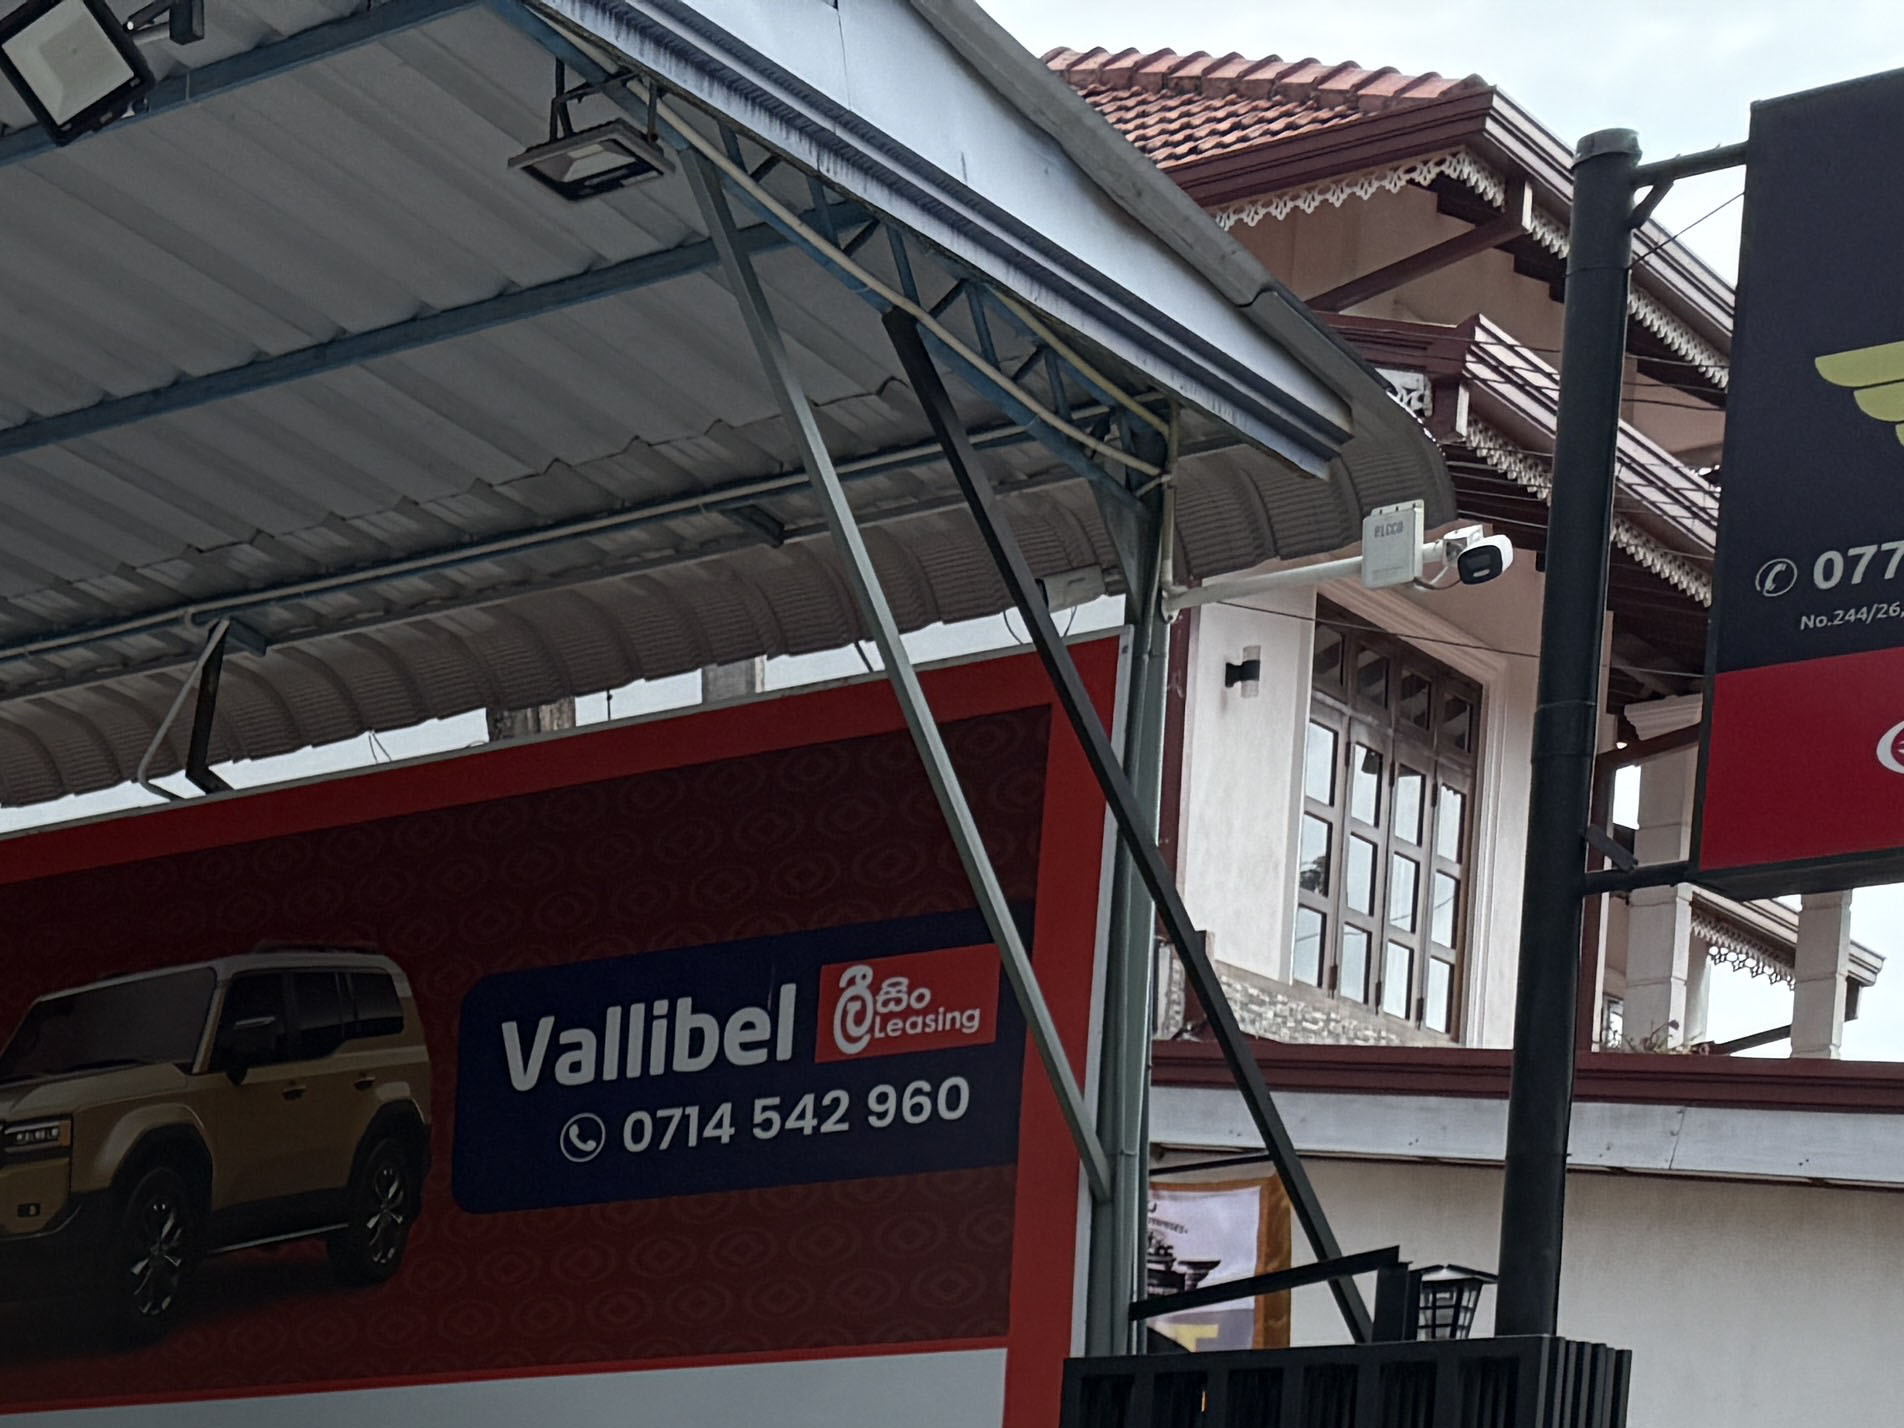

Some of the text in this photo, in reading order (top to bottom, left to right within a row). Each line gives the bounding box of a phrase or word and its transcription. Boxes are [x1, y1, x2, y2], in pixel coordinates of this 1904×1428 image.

[501, 982, 797, 1092] Vallibel
[874, 1006, 981, 1040] Leasing
[622, 1076, 971, 1154] 0714 542 960
